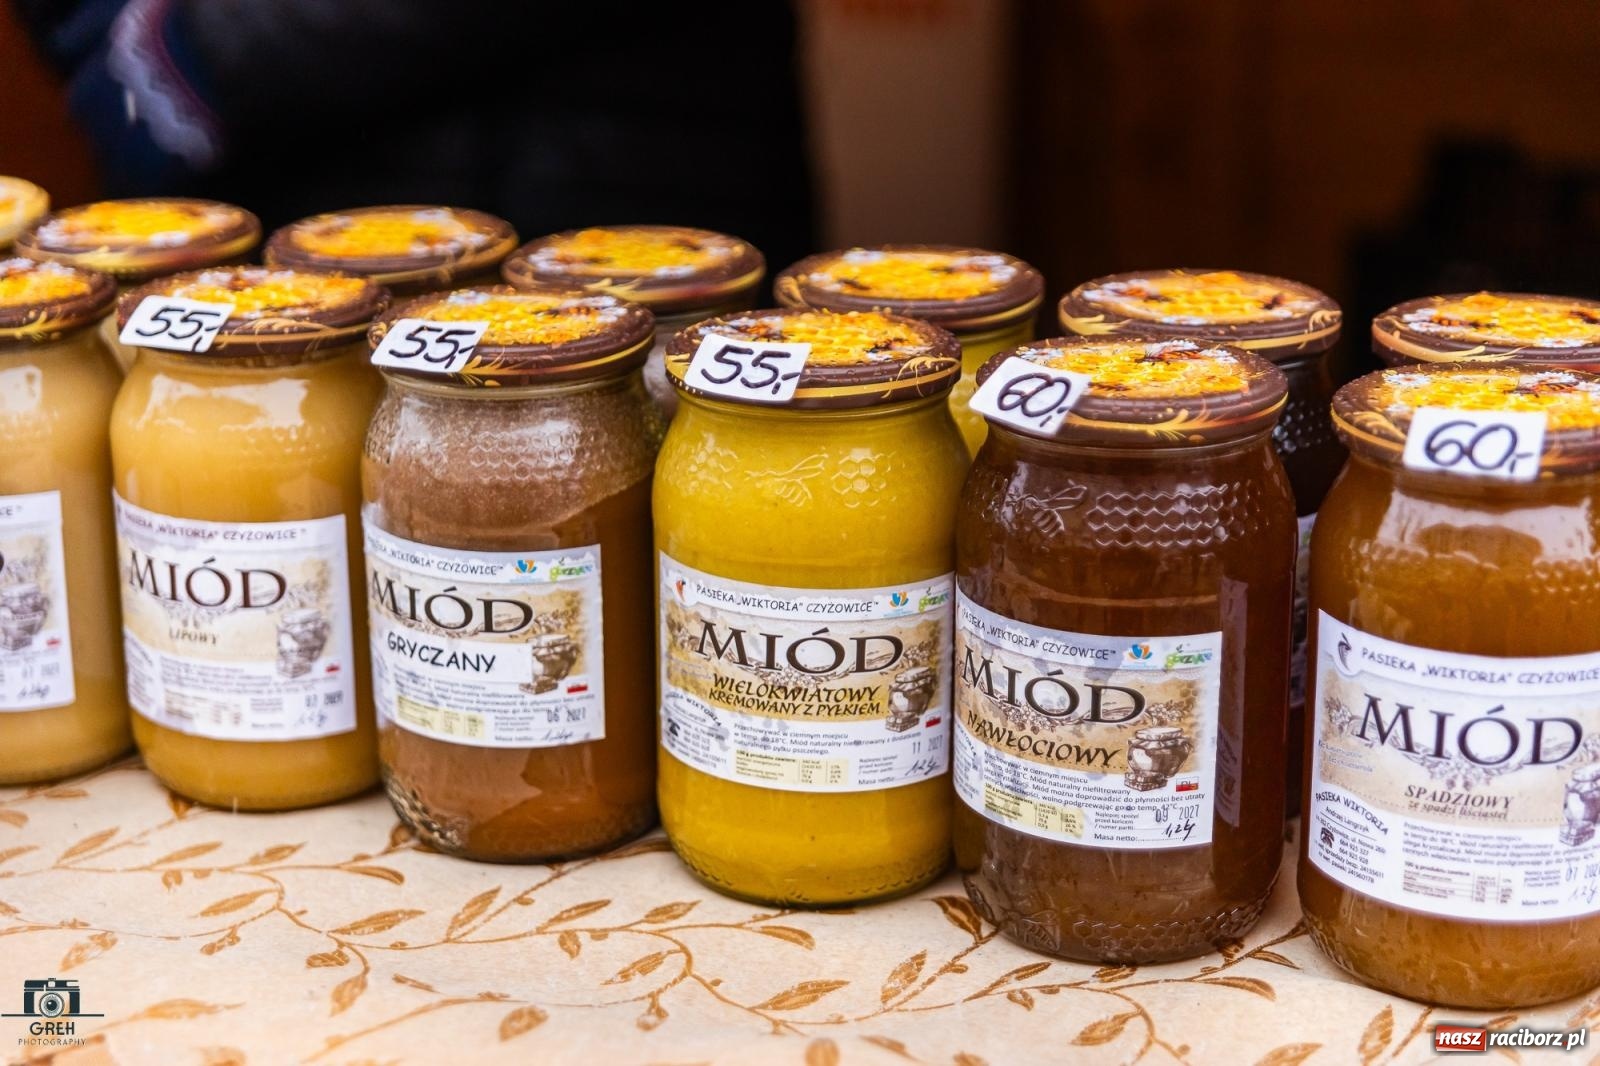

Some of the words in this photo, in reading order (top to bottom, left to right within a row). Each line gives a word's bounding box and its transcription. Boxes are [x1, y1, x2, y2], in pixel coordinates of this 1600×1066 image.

[128, 550, 287, 609] MIÓD
[371, 569, 534, 634] MIÓD
[695, 584, 735, 603] PASIEKA
[387, 631, 496, 674] GRYCZANY
[695, 618, 905, 675] MIÓD
[1361, 647, 1416, 672] PASIEKA
[713, 672, 881, 705] WIELOKWIATOWY
[961, 644, 1146, 724] MIÓD
[708, 687, 801, 715] KREMOWANY
[803, 703, 815, 715] Z
[967, 709, 1123, 767] NAWŁOCIOWY
[1355, 692, 1583, 767] MIÓD
[912, 742, 921, 755] 11
[1029, 767, 1060, 780] ciemnym
[1060, 773, 1088, 784] miejscu
[1030, 774, 1047, 785] Miód
[1048, 780, 1081, 792] naturalny
[1082, 785, 1131, 796] niefiltrowany
[1032, 783, 1049, 794] Miód
[1050, 789, 1073, 798] można
[1123, 795, 1133, 803] do
[1134, 794, 1170, 804] płynności
[1184, 792, 1206, 801] utraty
[1042, 795, 1063, 804] wolno
[1404, 784, 1515, 809] SPADZIOWY
[1155, 808, 1169, 823] 09
[1178, 804, 1200, 820] 2027
[1315, 791, 1341, 803] PASIEKA
[1342, 796, 1389, 835] WIKTORIA
[1094, 833, 1114, 841] Masa
